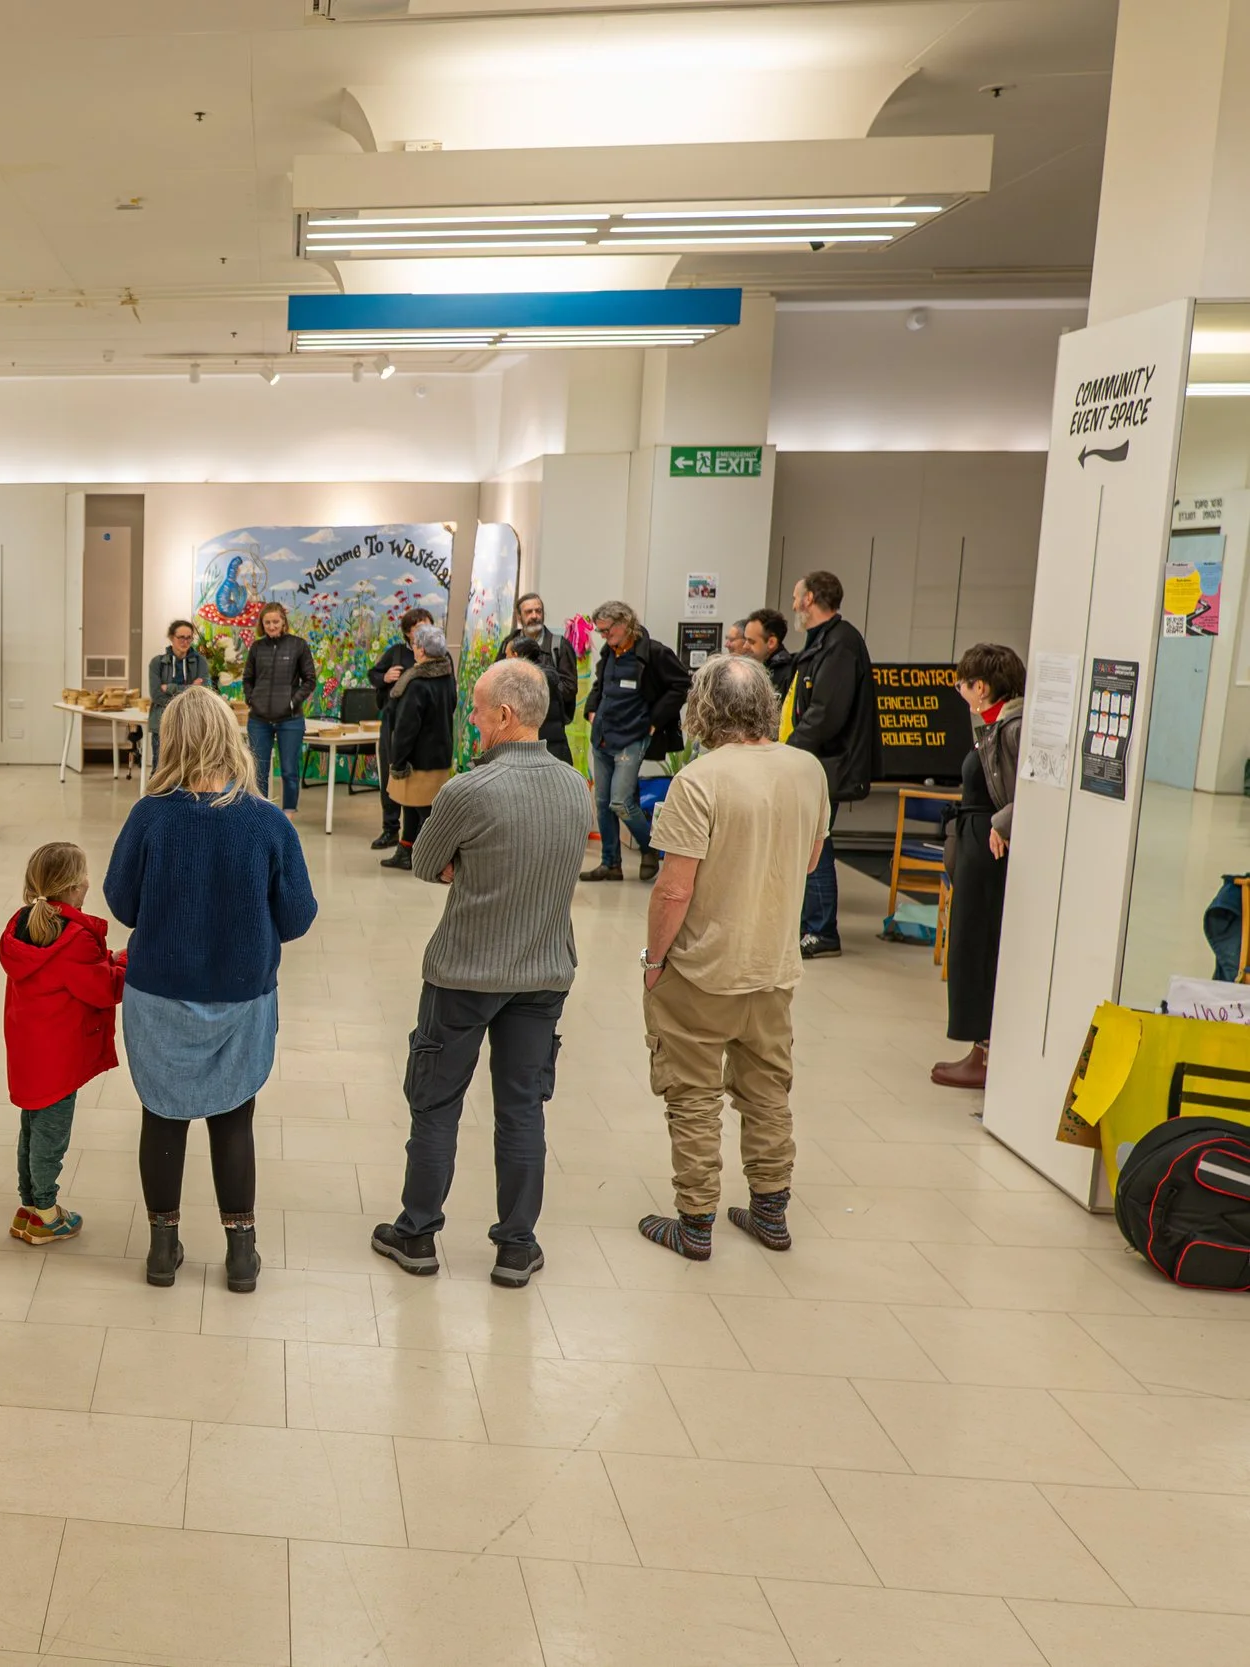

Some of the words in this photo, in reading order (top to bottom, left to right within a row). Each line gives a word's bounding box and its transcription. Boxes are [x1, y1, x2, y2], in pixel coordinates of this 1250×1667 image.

[1075, 364, 1156, 407] COMMUNITY
[1070, 405, 1109, 436] EVENT
[1108, 397, 1152, 430] SPACE
[714, 458, 758, 474] EXIT
[297, 544, 361, 595] Welcome
[364, 534, 384, 559] To
[877, 695, 939, 710] CANCELLED
[879, 714, 928, 728] DELAYED
[925, 731, 946, 746] CUT
